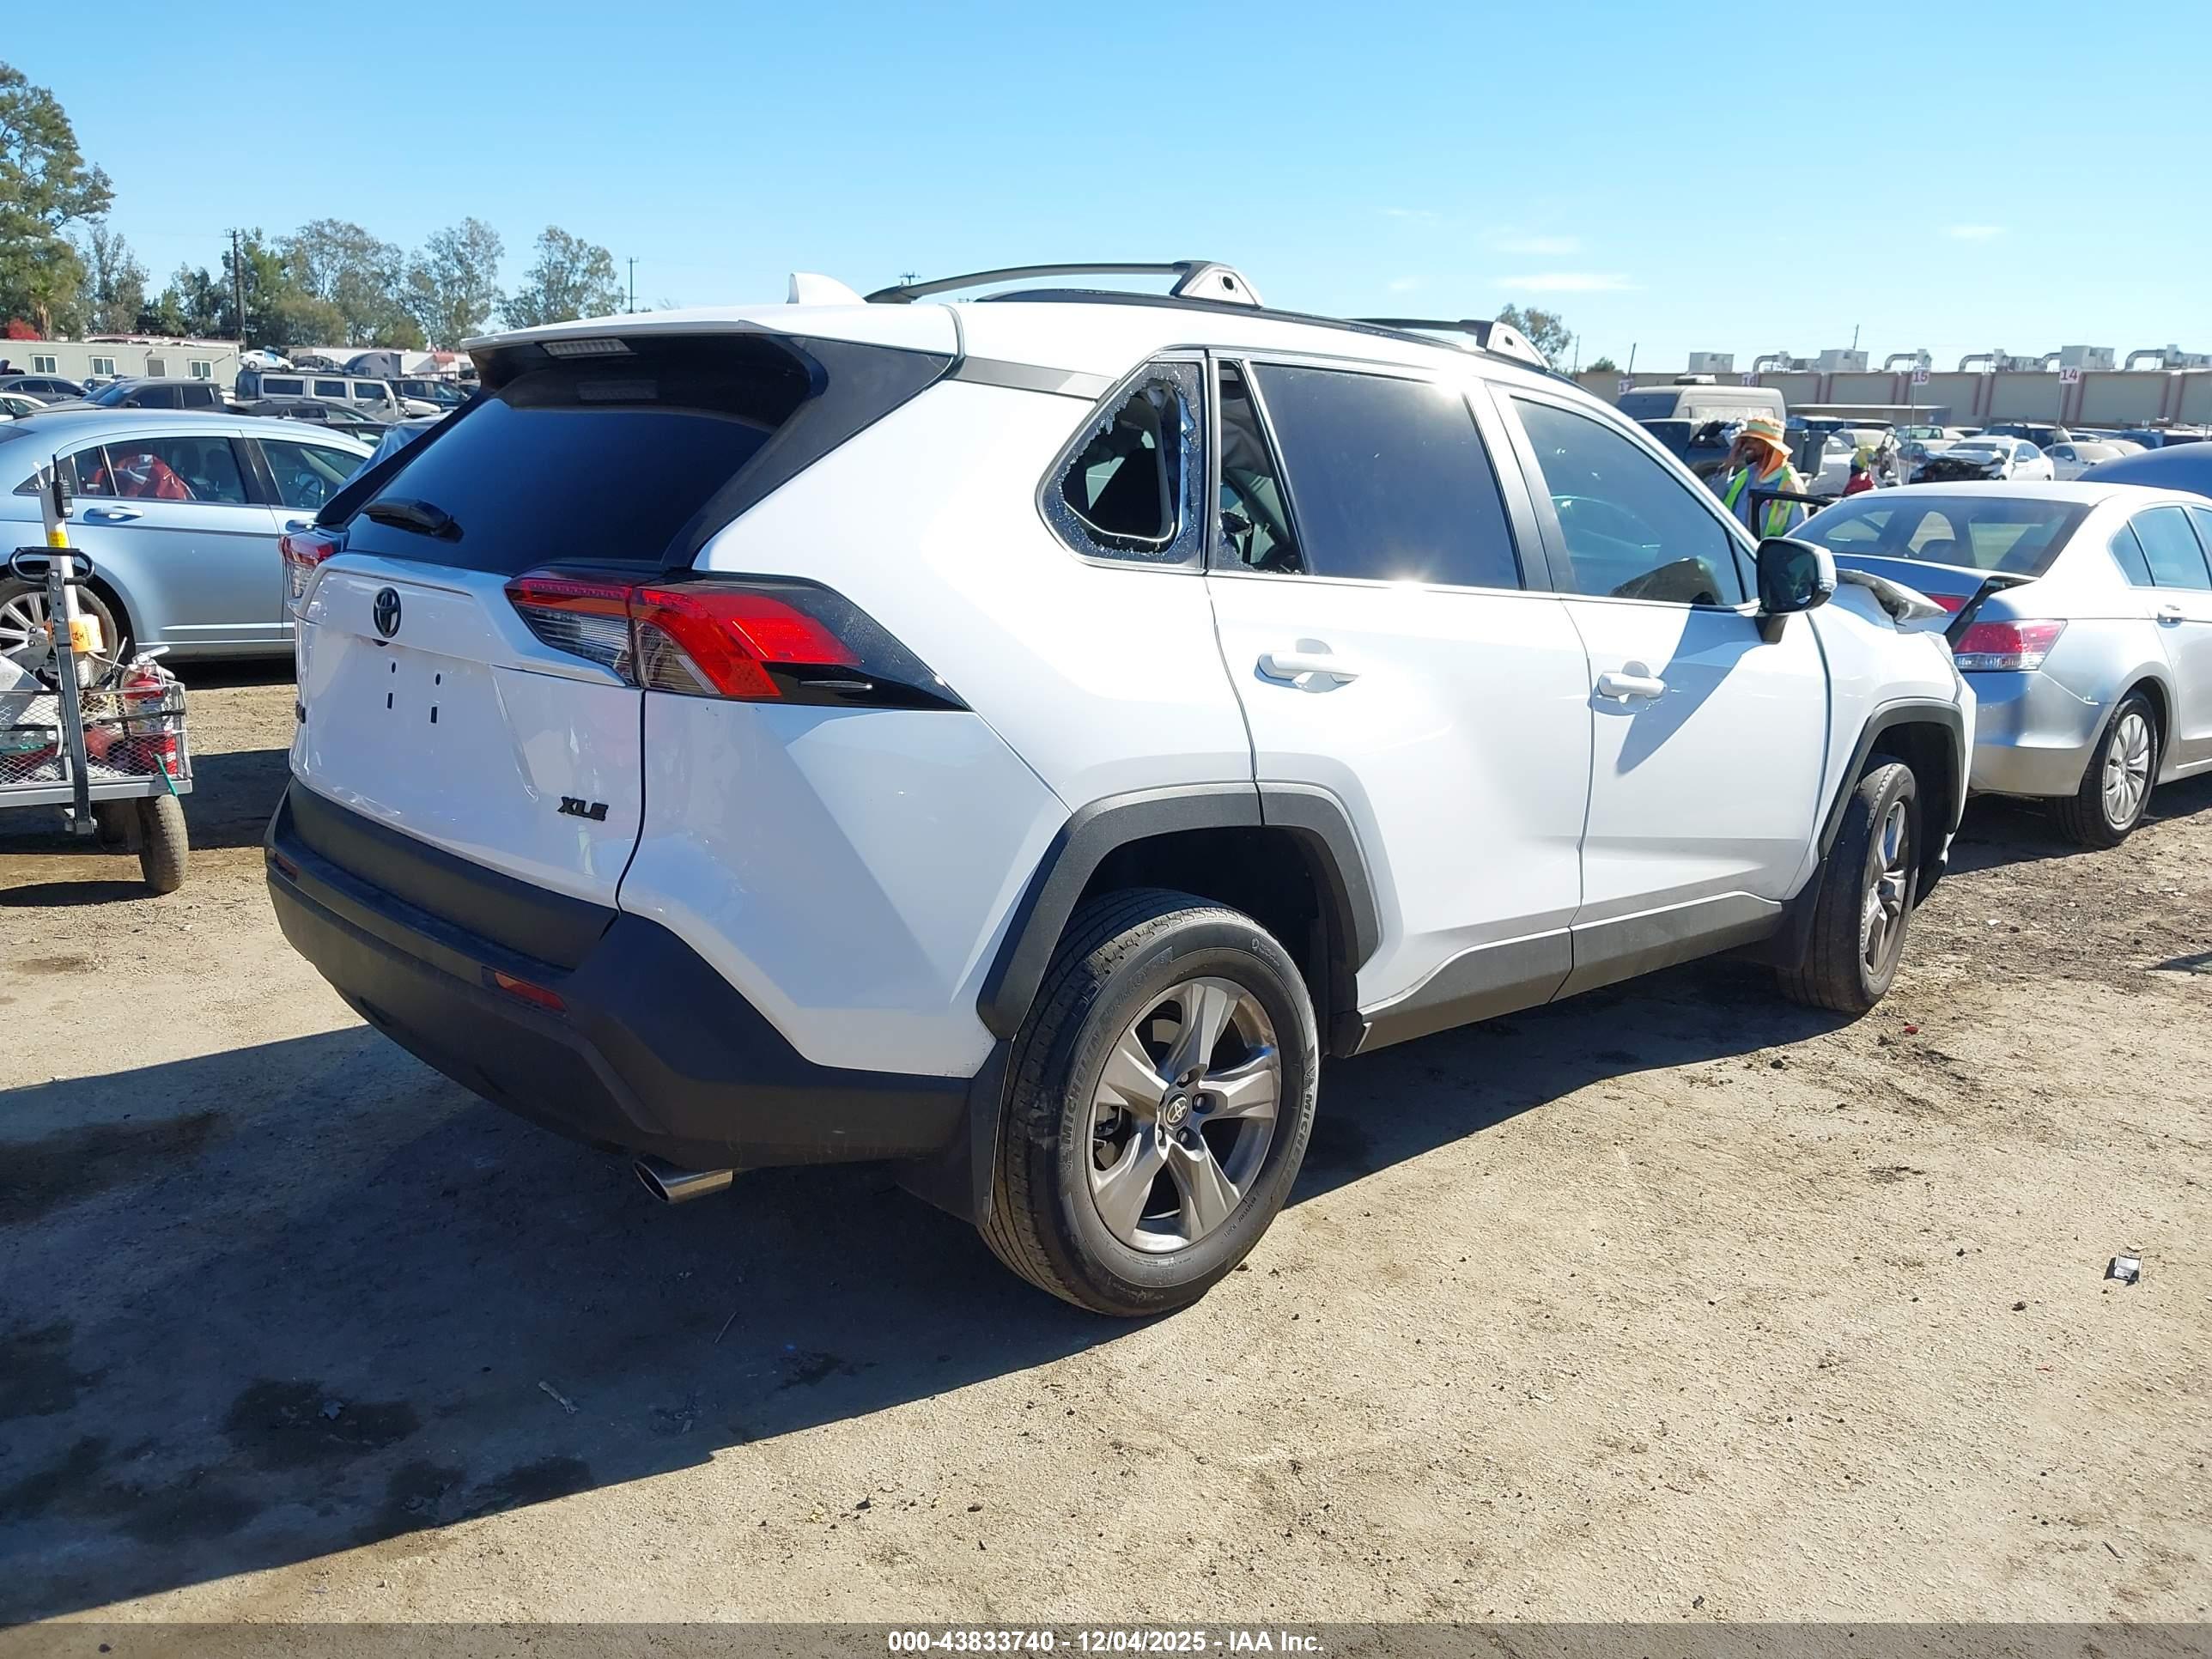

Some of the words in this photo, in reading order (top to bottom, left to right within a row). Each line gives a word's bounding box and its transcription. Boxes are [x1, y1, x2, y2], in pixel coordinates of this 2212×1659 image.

[1913, 372, 1929, 384] 15
[2061, 369, 2078, 381] 14
[556, 796, 610, 822] XLE
